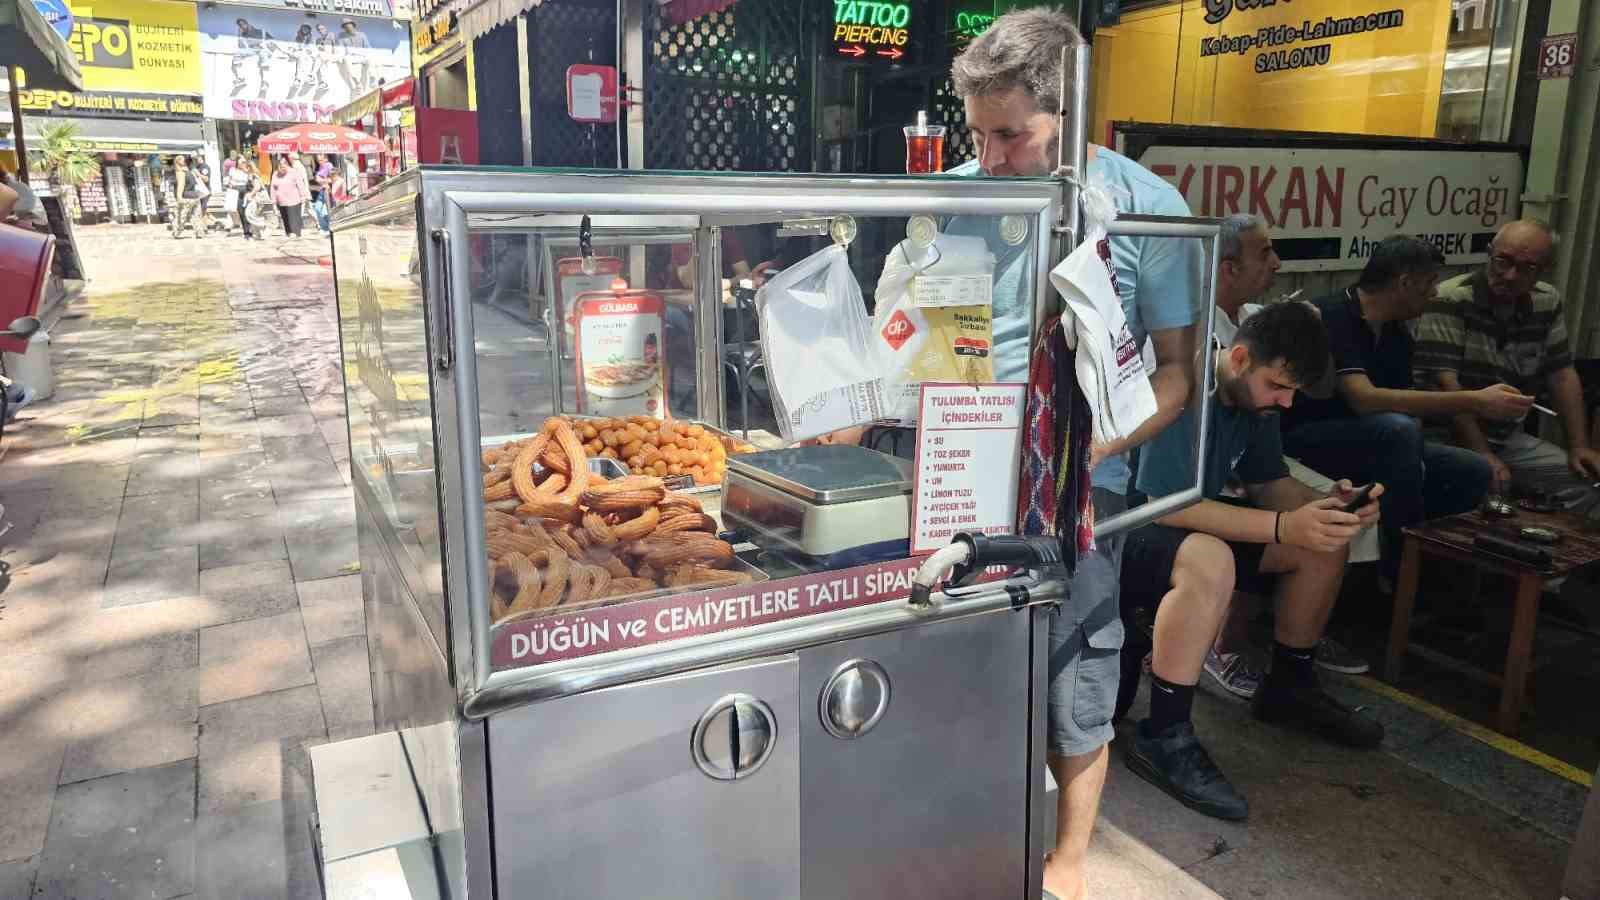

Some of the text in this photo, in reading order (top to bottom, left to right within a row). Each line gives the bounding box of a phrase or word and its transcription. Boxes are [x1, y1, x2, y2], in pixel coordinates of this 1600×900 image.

[834, 0, 910, 27] TATTOO
[834, 25, 908, 45] PIERCING
[1200, 9, 1404, 57] Kebap-Pide-Lahmacun
[70, 23, 128, 62] EPO
[1255, 44, 1331, 72] SALONU
[1544, 45, 1570, 67] 36
[18, 89, 73, 110] DEPO
[1358, 175, 1419, 229] Çay
[1426, 176, 1510, 228] Ocağı
[931, 396, 1016, 407] TULUMBA TATLISI
[942, 410, 1003, 424] İÇİNDEKİLER
[933, 437, 944, 445] SU
[933, 450, 970, 460] TOZ ŞEKER
[932, 463, 966, 473] YUMURTA
[930, 488, 972, 498] LİMON TUZU
[930, 502, 960, 513] AYÇİÇEK
[958, 514, 977, 523] EMEK
[928, 528, 952, 539] KADER
[511, 617, 609, 659] DÜĞÜN
[616, 618, 647, 640] ve
[655, 588, 799, 633] CEMİYETLERE
[806, 577, 858, 606] TATLI
